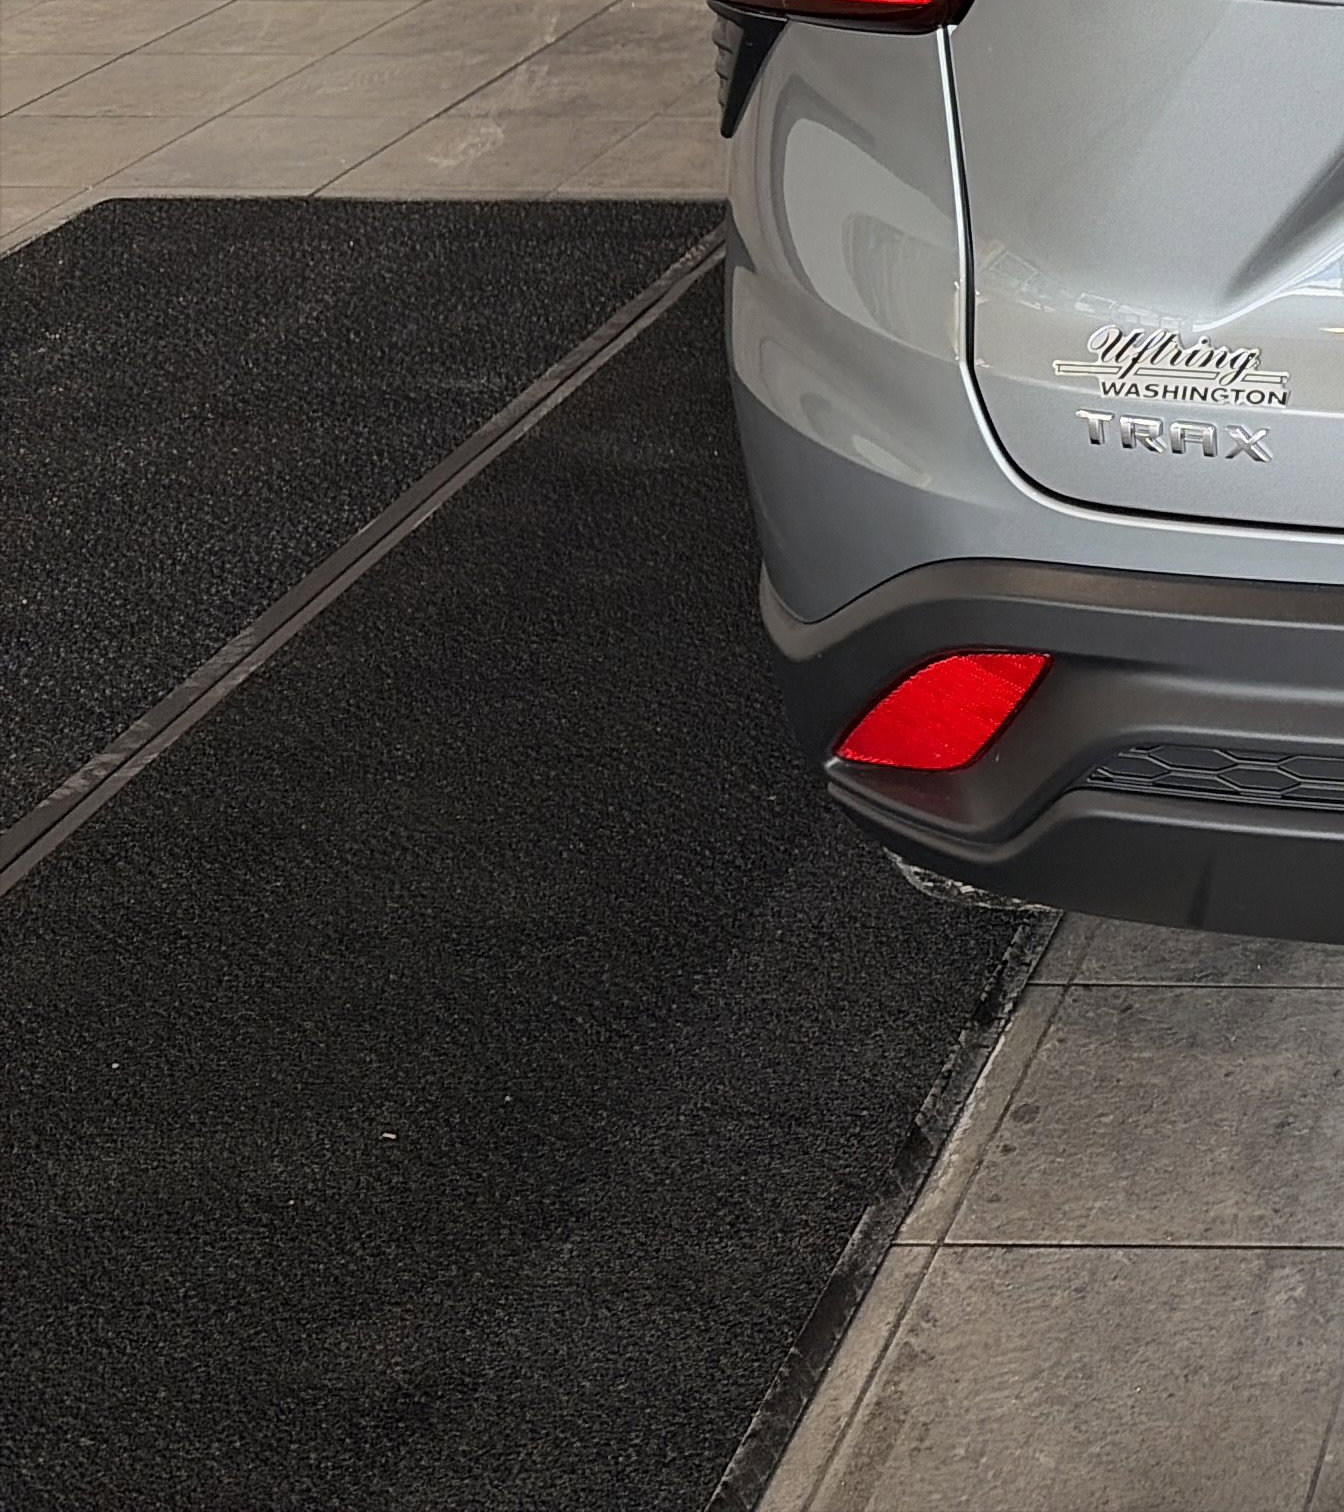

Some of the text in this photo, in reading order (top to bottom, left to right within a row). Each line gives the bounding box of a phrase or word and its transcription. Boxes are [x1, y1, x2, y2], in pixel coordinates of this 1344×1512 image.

[1088, 326, 1259, 386] Uftring
[1100, 381, 1288, 406] WASHINGTON
[1076, 408, 1273, 463] TRAX
